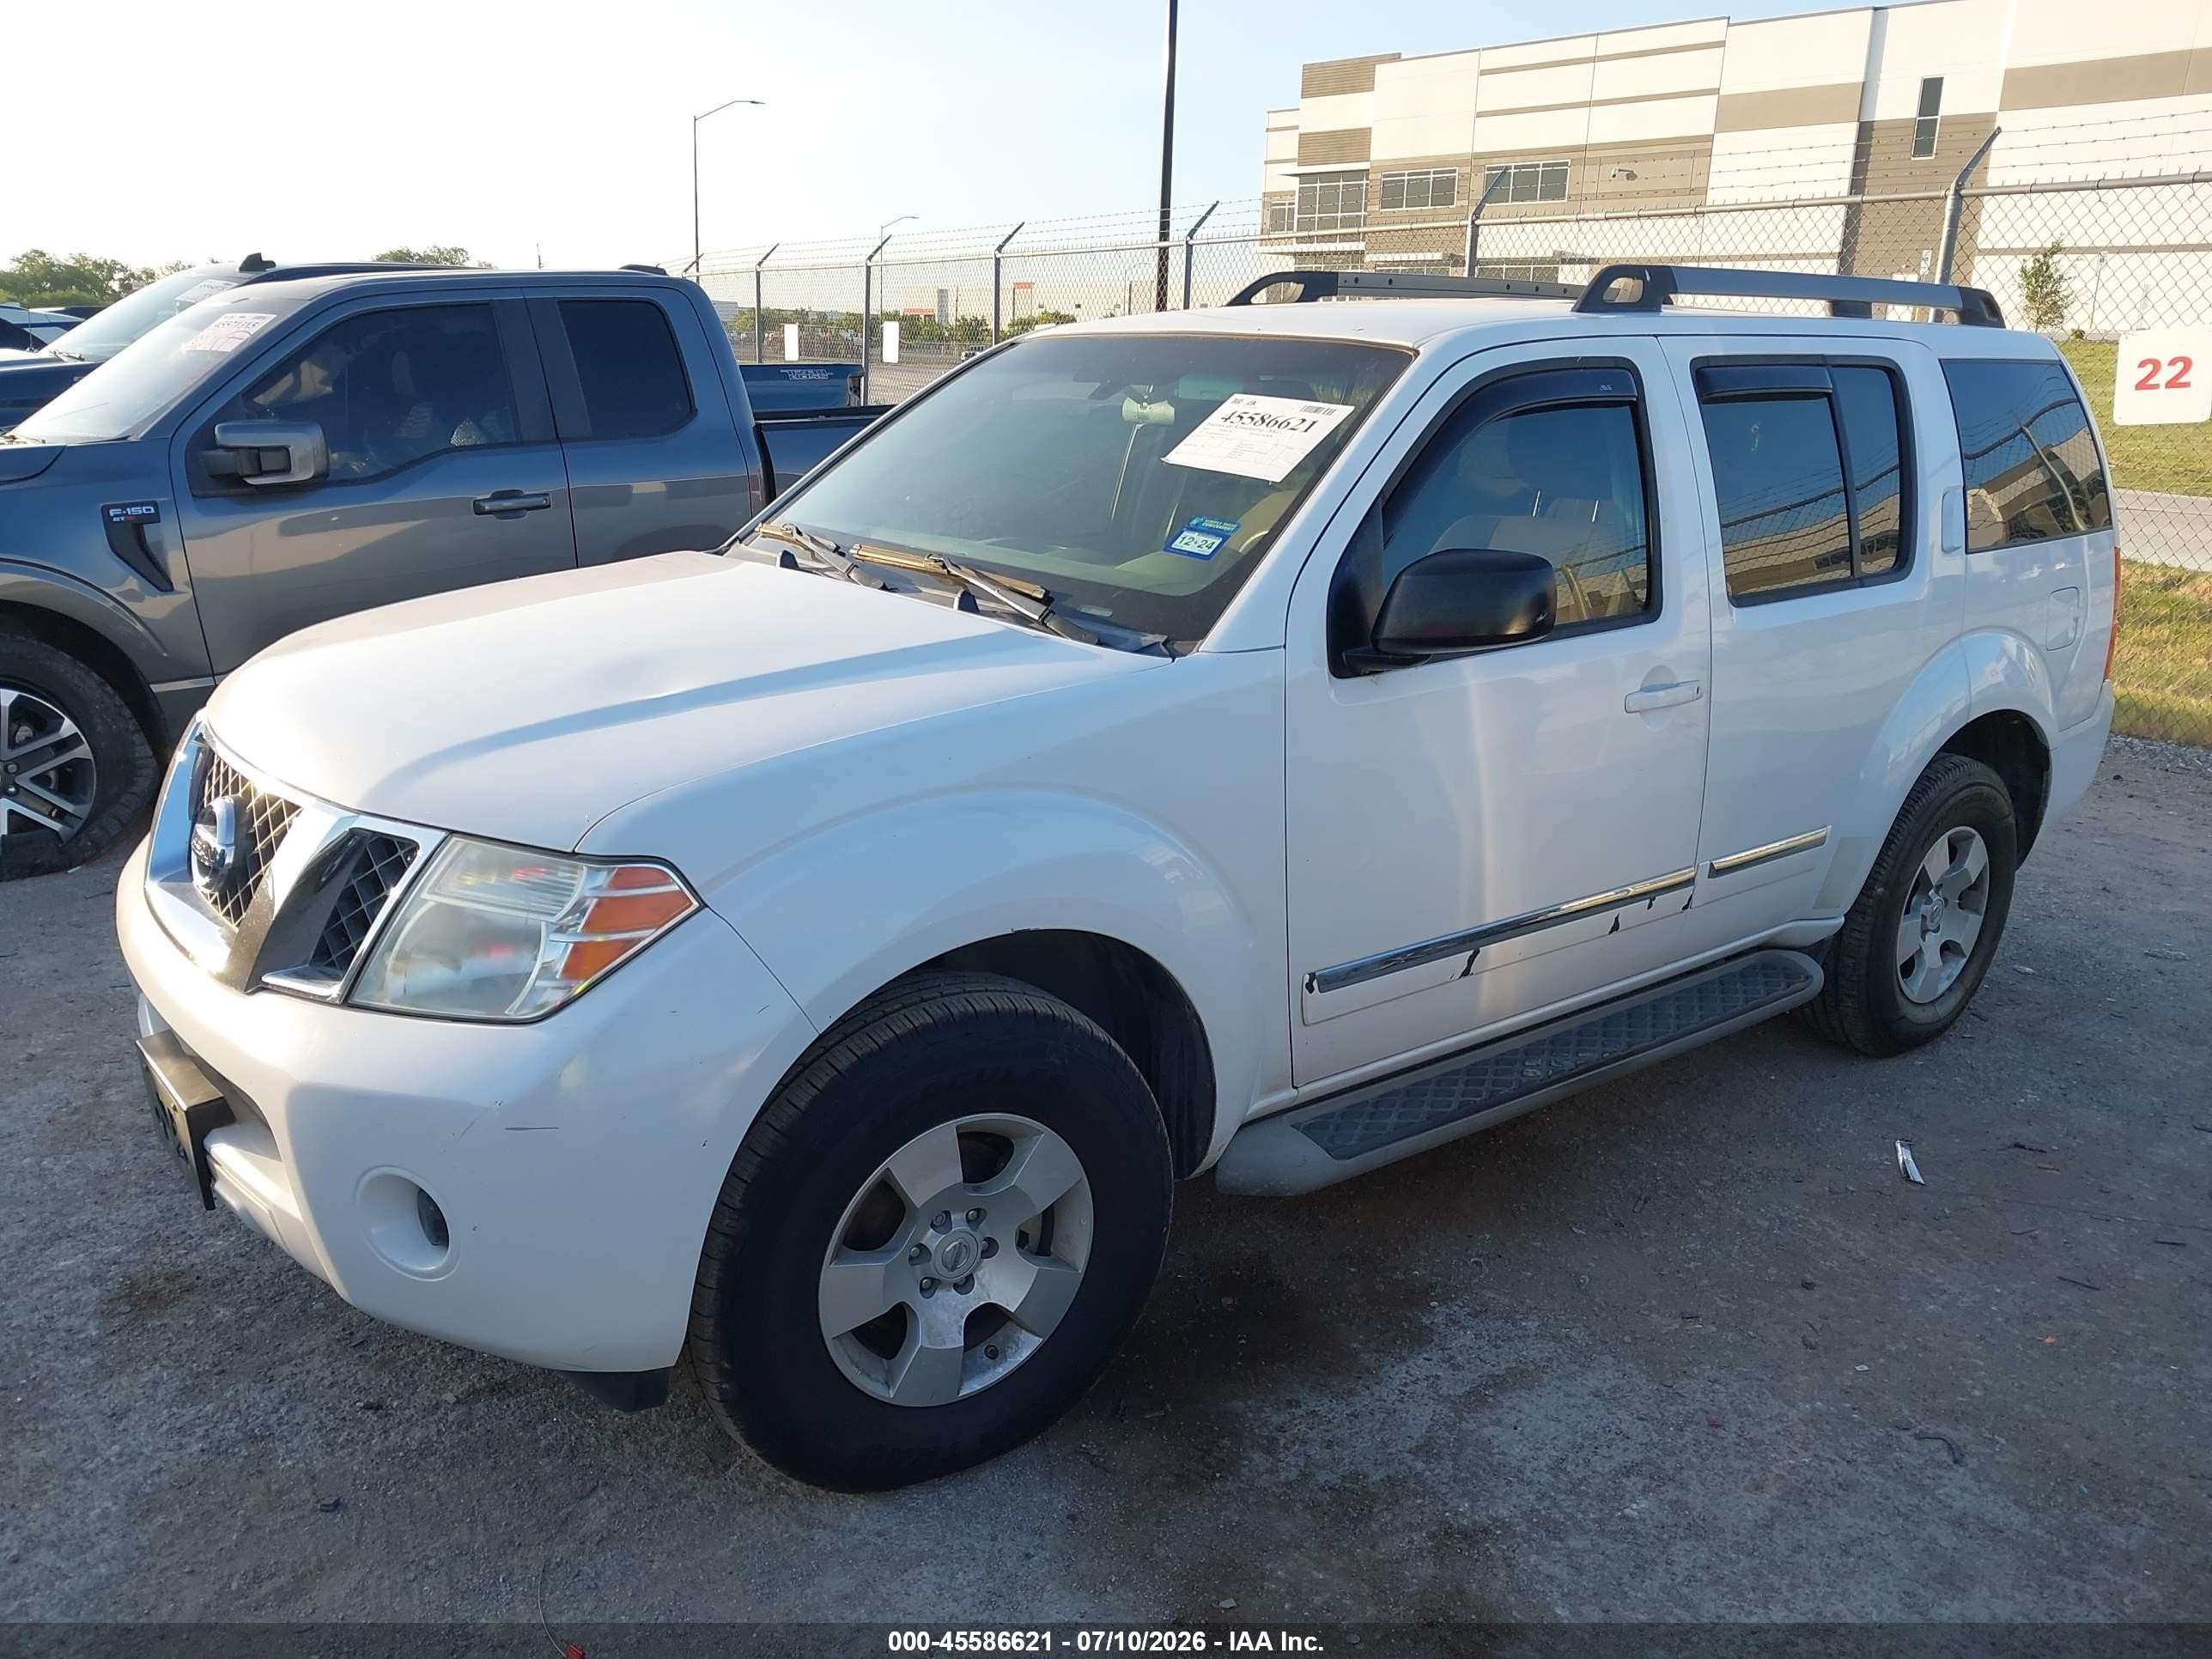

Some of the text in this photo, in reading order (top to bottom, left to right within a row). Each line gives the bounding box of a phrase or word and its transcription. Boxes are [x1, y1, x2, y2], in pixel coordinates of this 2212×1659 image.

[2134, 356, 2193, 391] 22
[1220, 410, 1319, 434] 45586621
[109, 506, 155, 517] F-150
